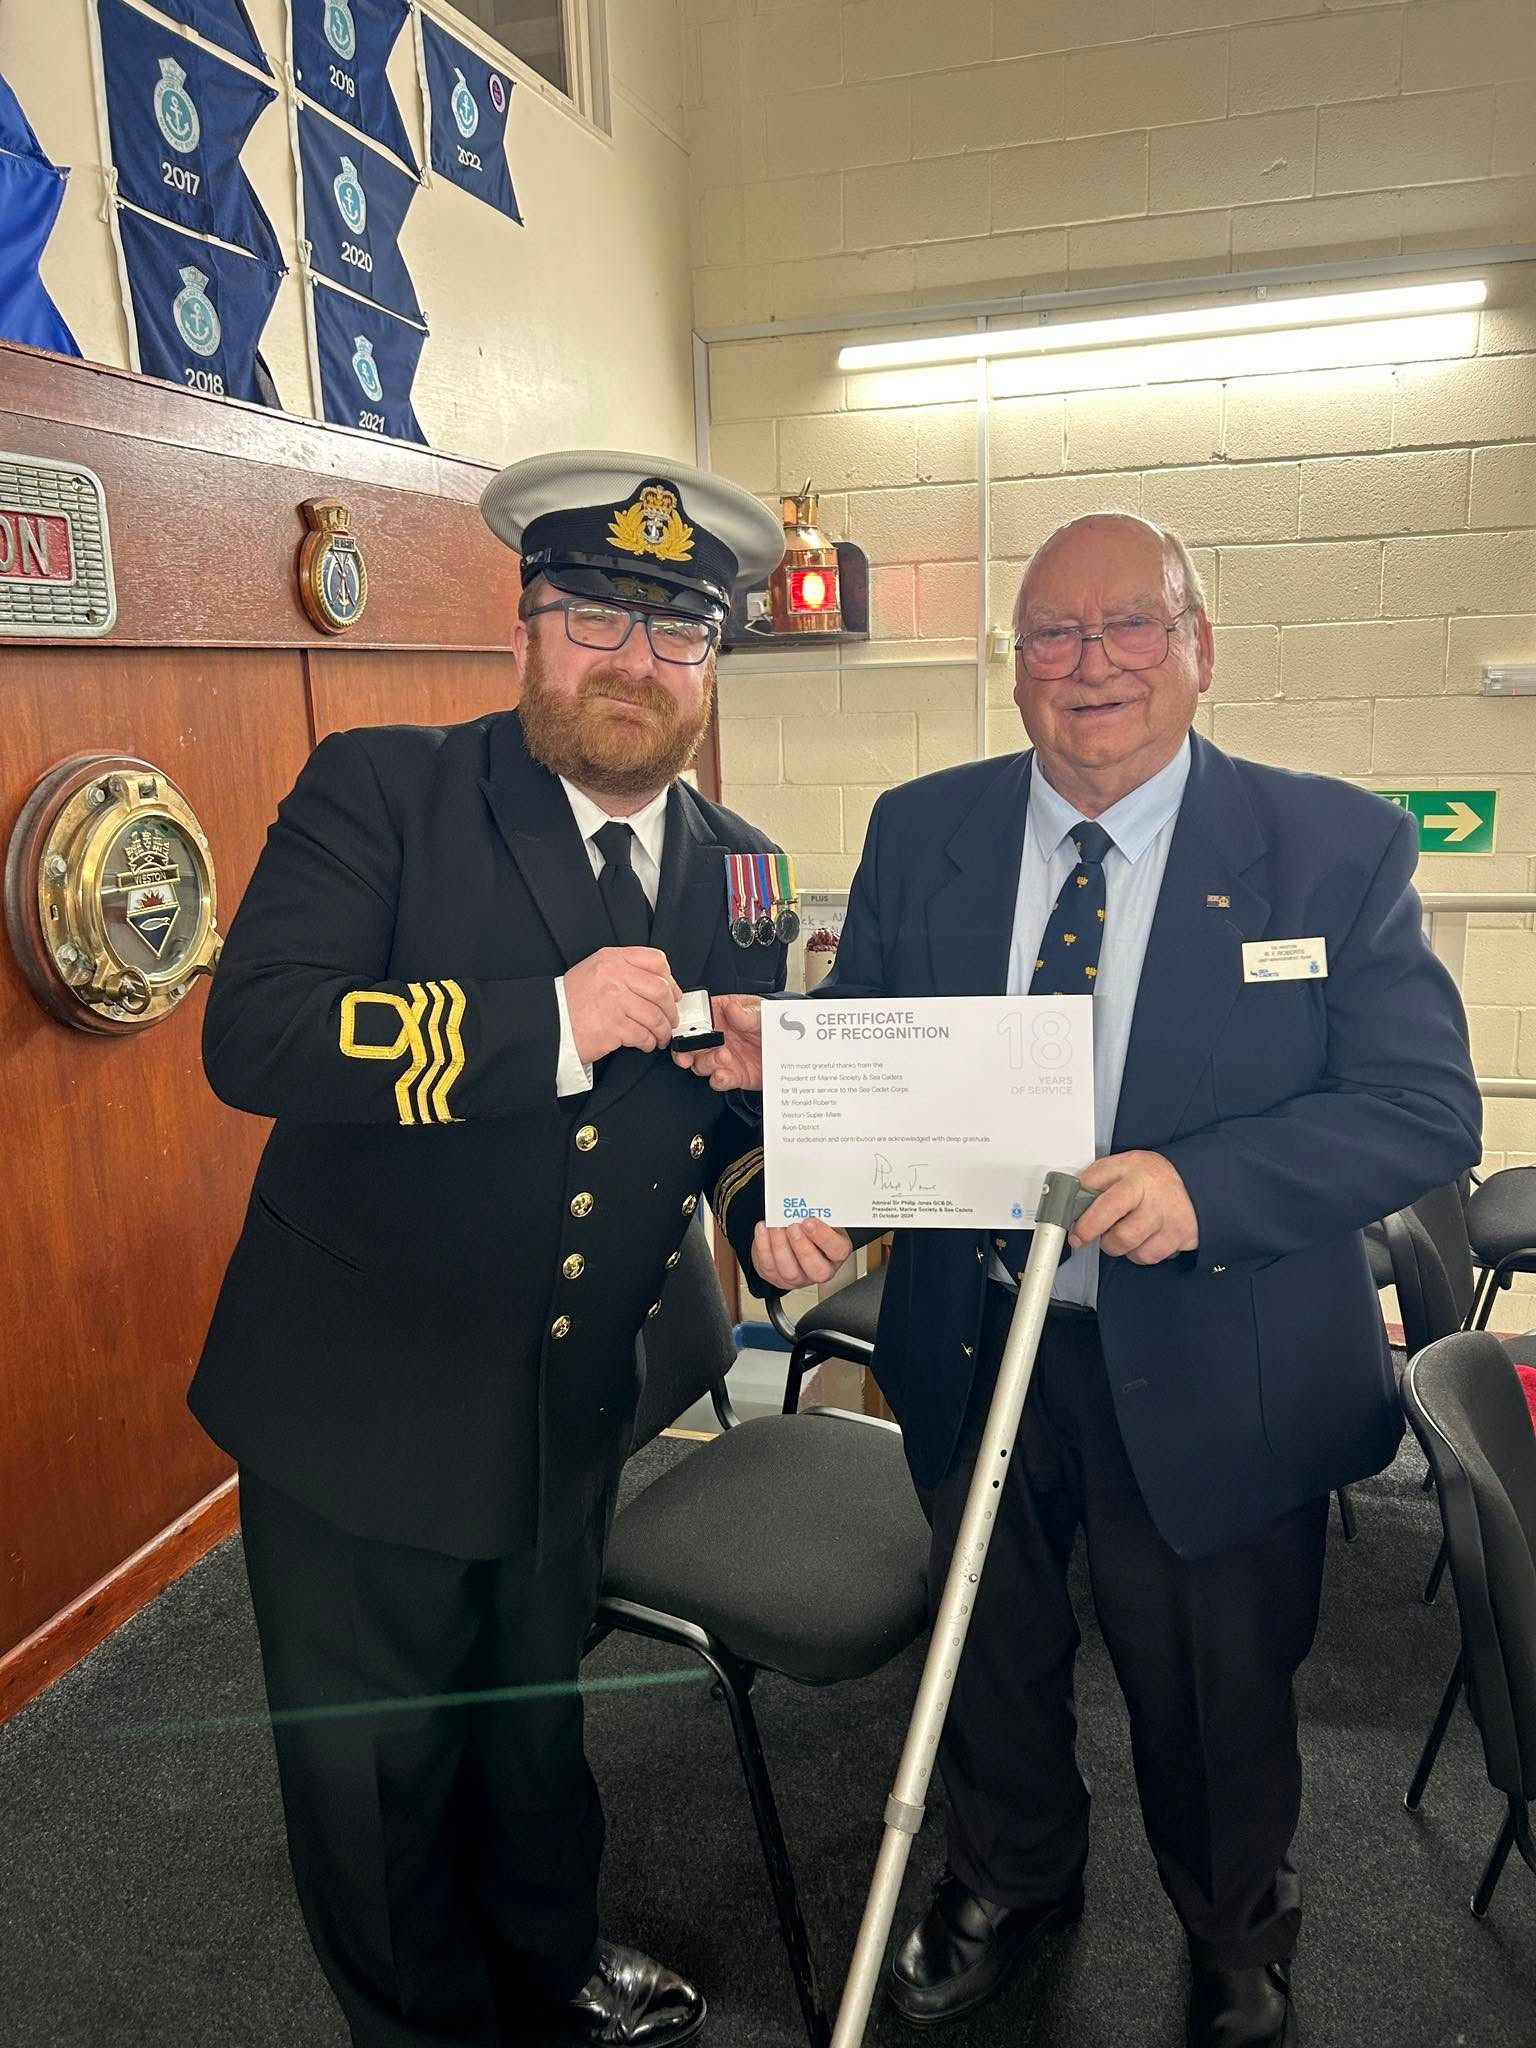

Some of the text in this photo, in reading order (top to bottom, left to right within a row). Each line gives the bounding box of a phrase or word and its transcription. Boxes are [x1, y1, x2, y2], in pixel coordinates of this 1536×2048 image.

[330, 65, 355, 98] 2019
[457, 145, 483, 172] 2022
[162, 162, 200, 196] 2017
[341, 241, 372, 272] 2020
[185, 368, 224, 396] 2018
[359, 410, 385, 432] 2021
[134, 871, 167, 885] WESTON
[816, 1012, 914, 1025] CERTIFICATE
[816, 1026, 949, 1040] OF RECOGNITION
[996, 1011, 1072, 1070] 18
[1040, 1076, 1072, 1085] YEARS
[1011, 1086, 1072, 1095] OF SERVICE
[784, 1198, 806, 1208] SEA
[784, 1208, 832, 1218] CADETS
